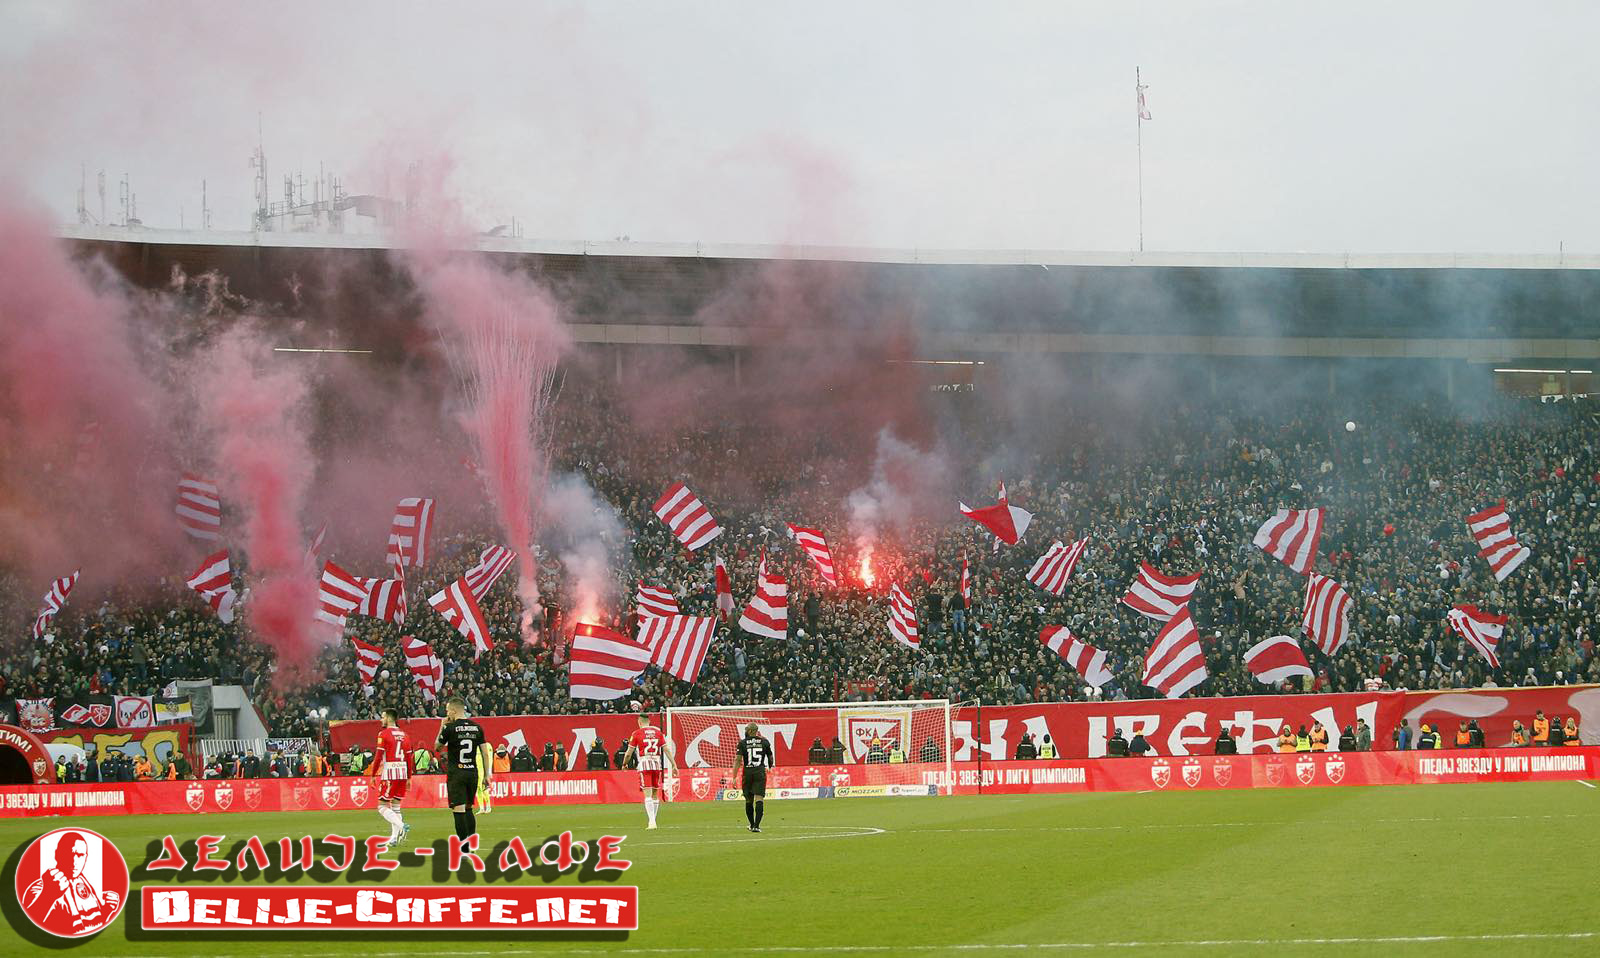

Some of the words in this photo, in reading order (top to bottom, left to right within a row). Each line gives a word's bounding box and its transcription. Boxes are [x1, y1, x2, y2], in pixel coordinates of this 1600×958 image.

[855, 728, 872, 737] ФК
[395, 740, 405, 762] 4
[460, 739, 473, 763] 2
[643, 738, 659, 756] 23
[746, 747, 763, 767] 15
[1419, 758, 1455, 775] ГЛЕДАЈ
[1456, 757, 1493, 774] ЗВЕЗДУ
[1495, 757, 1501, 773] У
[1504, 756, 1529, 772] ЛИГИ
[1531, 755, 1586, 772] ШАМПИОНА
[997, 769, 1004, 785] У
[1006, 768, 1030, 785] ЛИГИ
[1032, 767, 1086, 784] ШАМПИОНА
[511, 781, 518, 797] У
[520, 780, 544, 796] ЛИГИ
[546, 779, 598, 796] ШАМПИОНА
[6, 793, 40, 810] ЗВЕЗДУ
[42, 793, 48, 808] У
[50, 792, 73, 807] ЛИГИ
[75, 790, 125, 807] ШАМПИОНА
